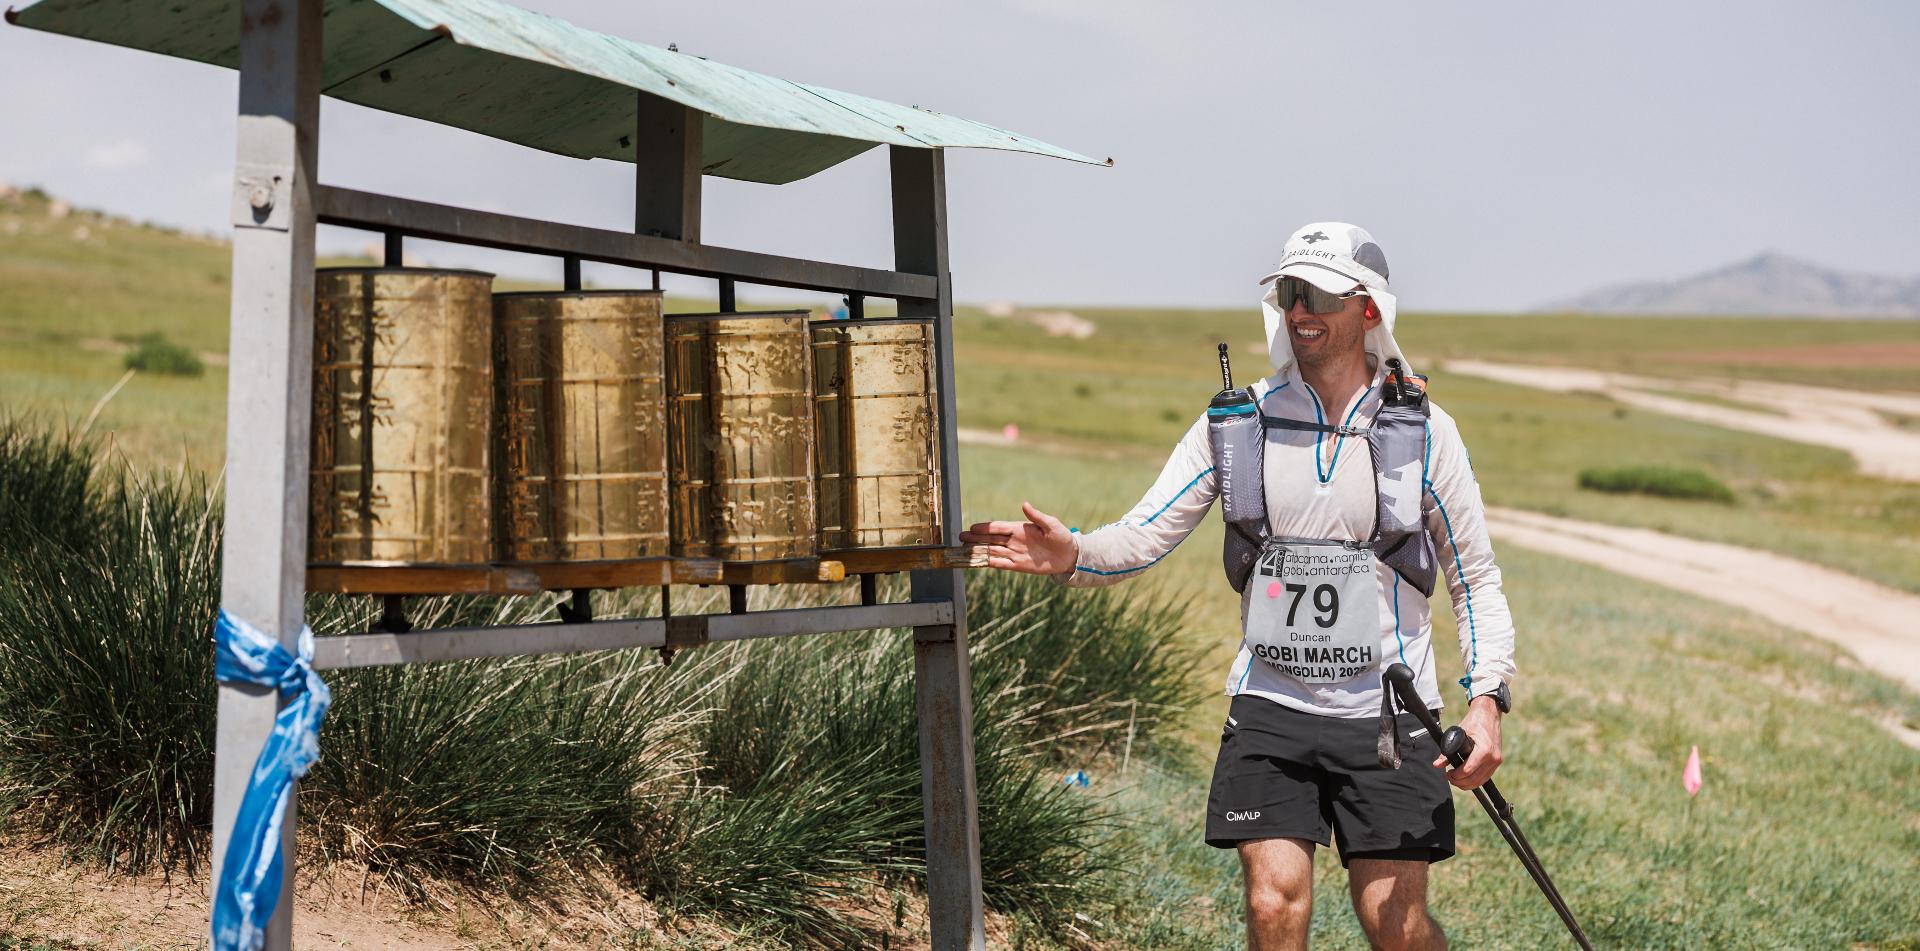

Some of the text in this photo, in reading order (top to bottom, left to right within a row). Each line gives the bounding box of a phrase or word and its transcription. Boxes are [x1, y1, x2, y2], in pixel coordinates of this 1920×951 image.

[1222, 442, 1234, 511] RAIDLIGHT
[1285, 583, 1340, 629] 79
[1290, 632, 1331, 642] Duncan
[1254, 643, 1372, 664] GOBI MARCH
[1264, 660, 1336, 680] MONGOLIA)
